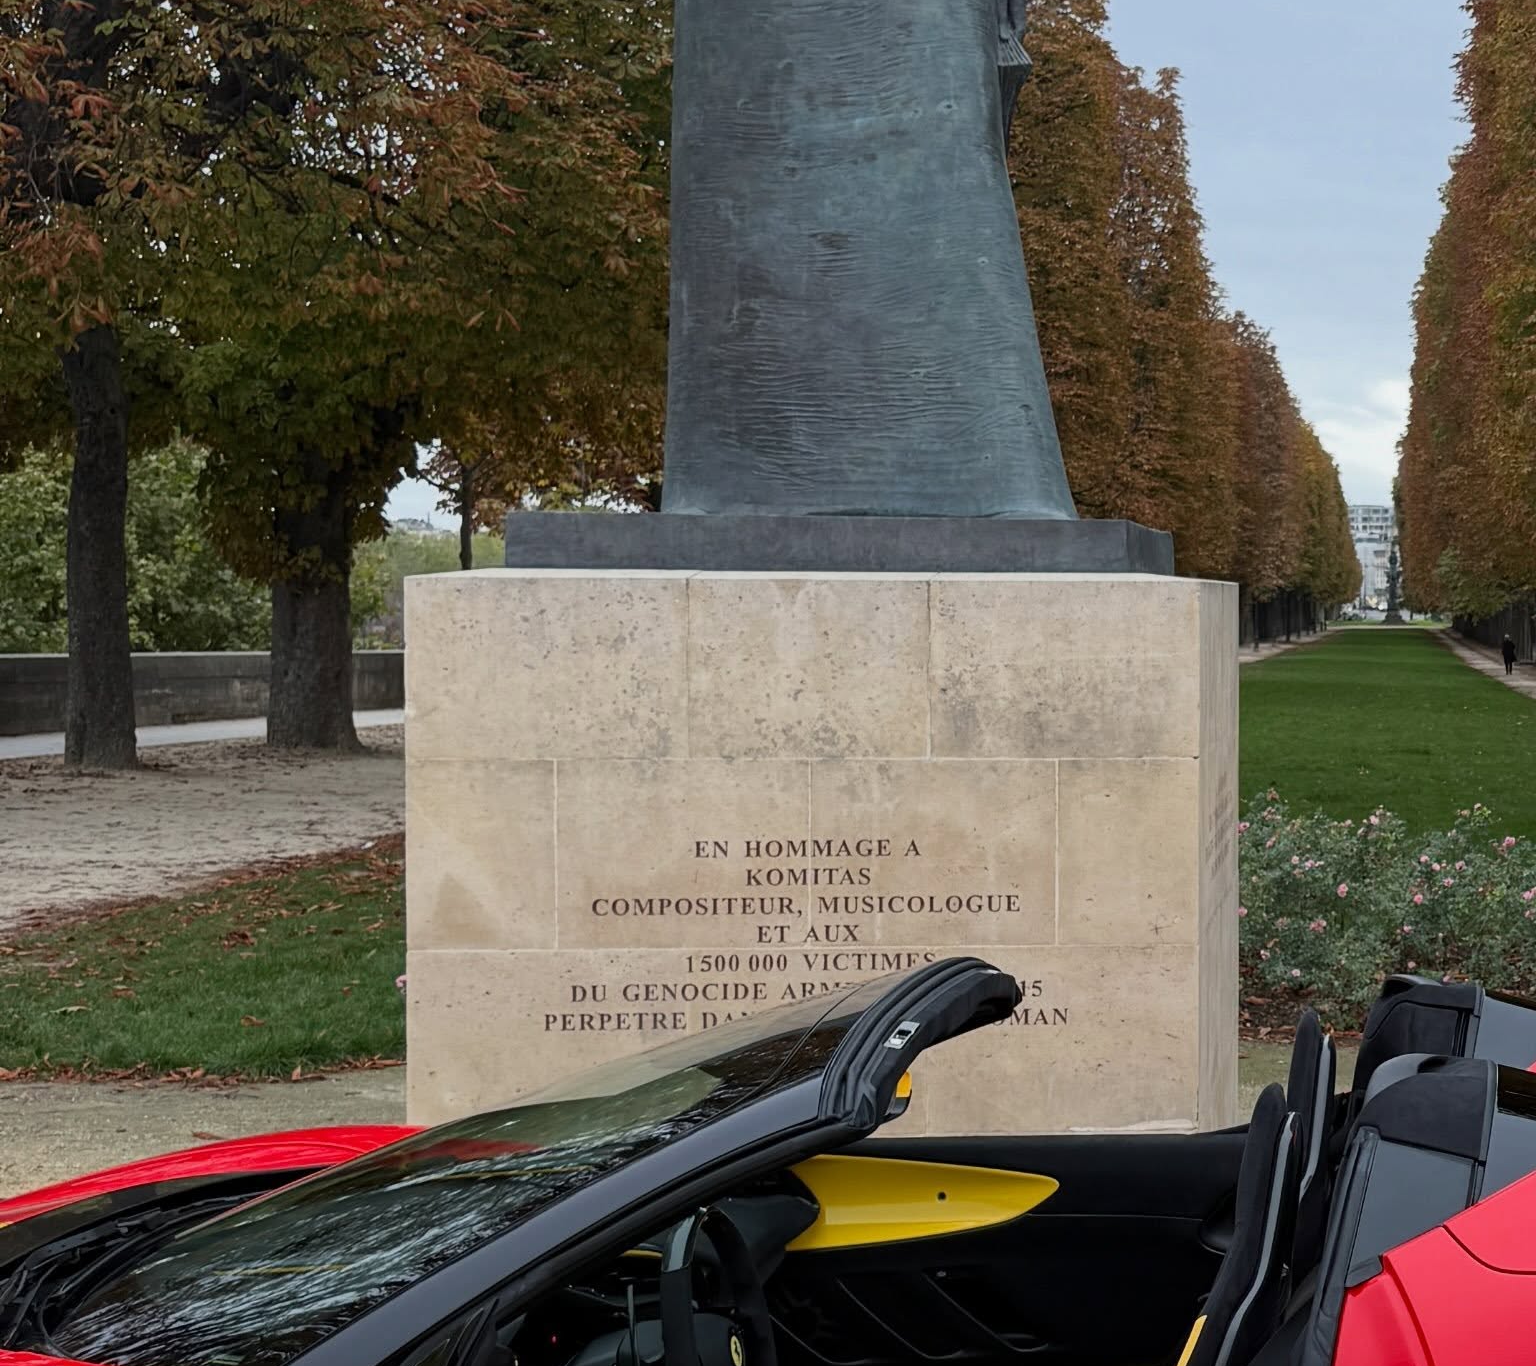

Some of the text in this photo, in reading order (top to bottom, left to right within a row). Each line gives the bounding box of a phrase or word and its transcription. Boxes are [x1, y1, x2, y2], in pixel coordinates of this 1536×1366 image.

[694, 838, 922, 859] EN HOMMAGE A
[745, 867, 872, 887] KOMITAS
[591, 894, 1021, 918] COMPOSITEUR, MUSICOLOGUE
[756, 924, 861, 944] ET AUX
[570, 984, 607, 1003] DU
[622, 982, 768, 1003] GENOCIDE
[544, 1011, 687, 1032] PERPETRE
